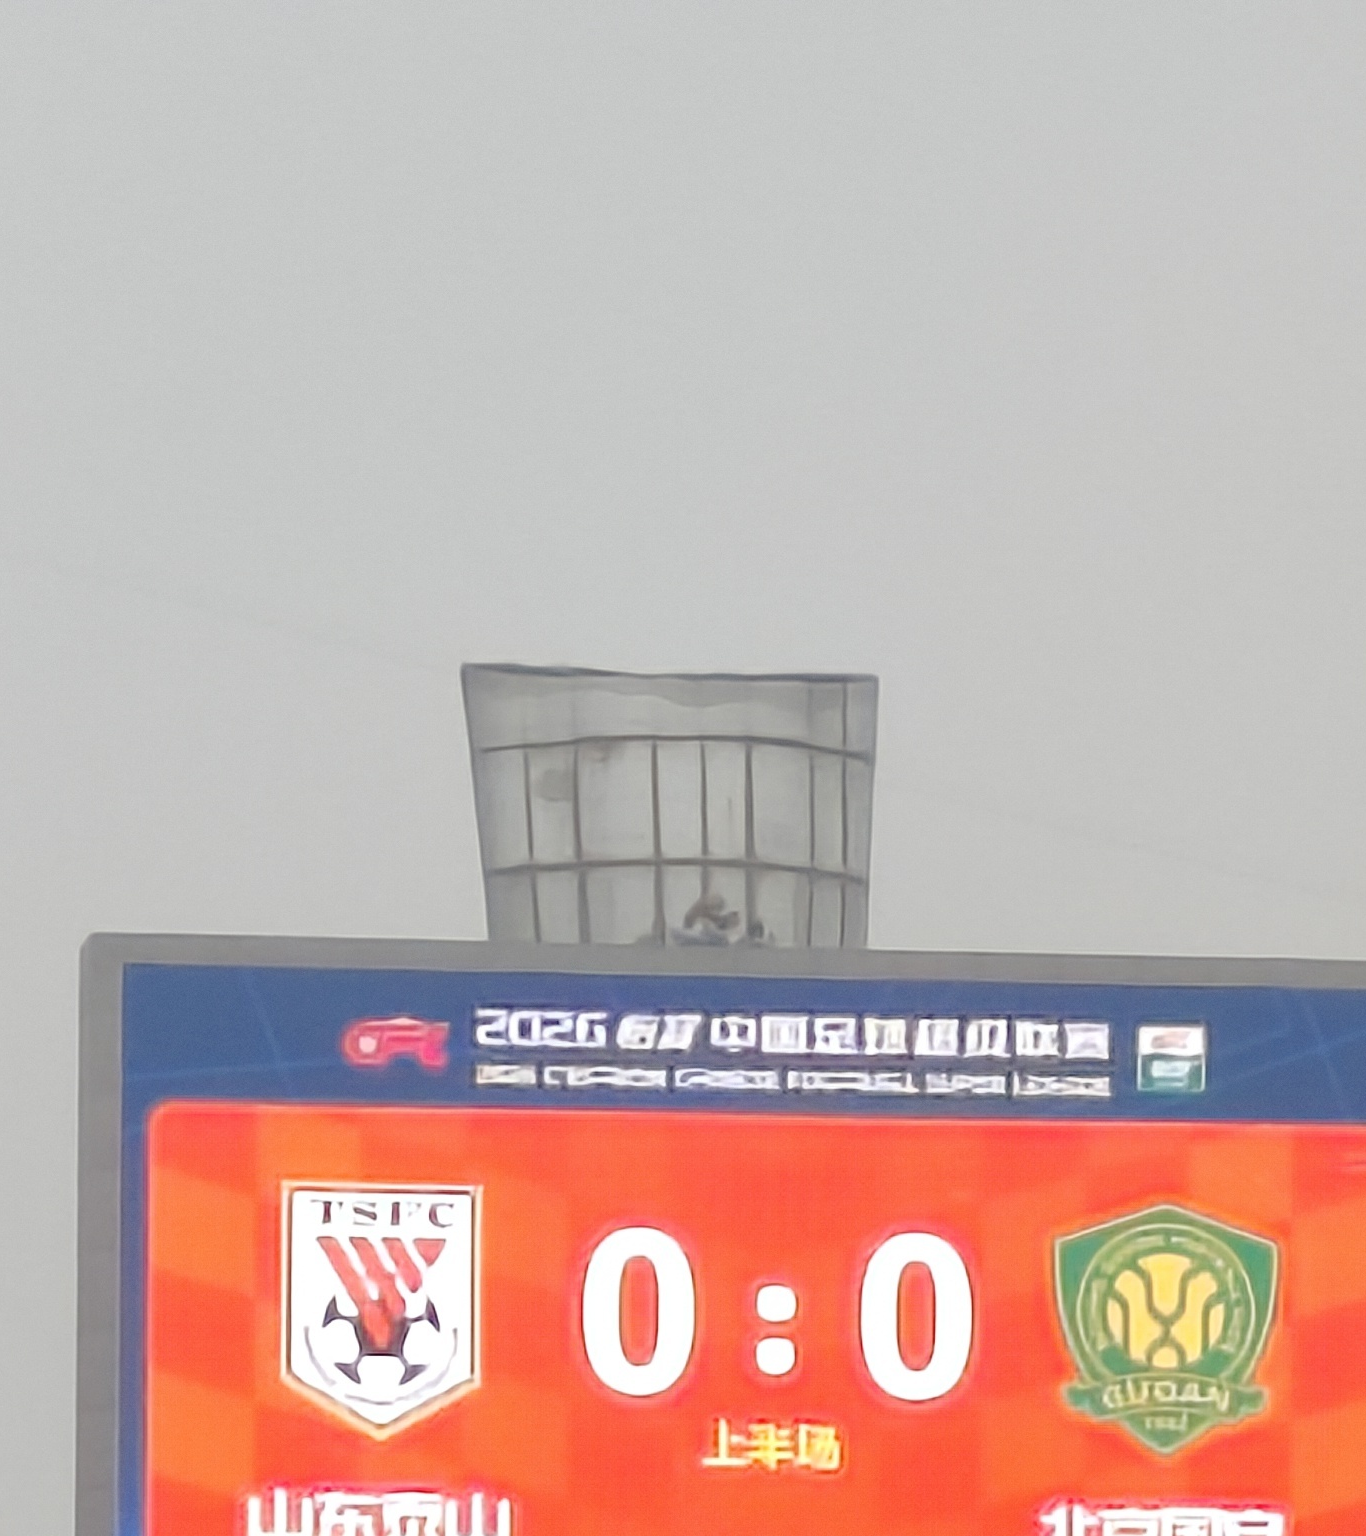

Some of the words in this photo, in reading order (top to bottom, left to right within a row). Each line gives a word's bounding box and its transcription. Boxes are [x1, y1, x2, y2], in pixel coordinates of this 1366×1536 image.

[476, 1009, 607, 1048] 2026
[702, 1417, 841, 1470] 上半场
